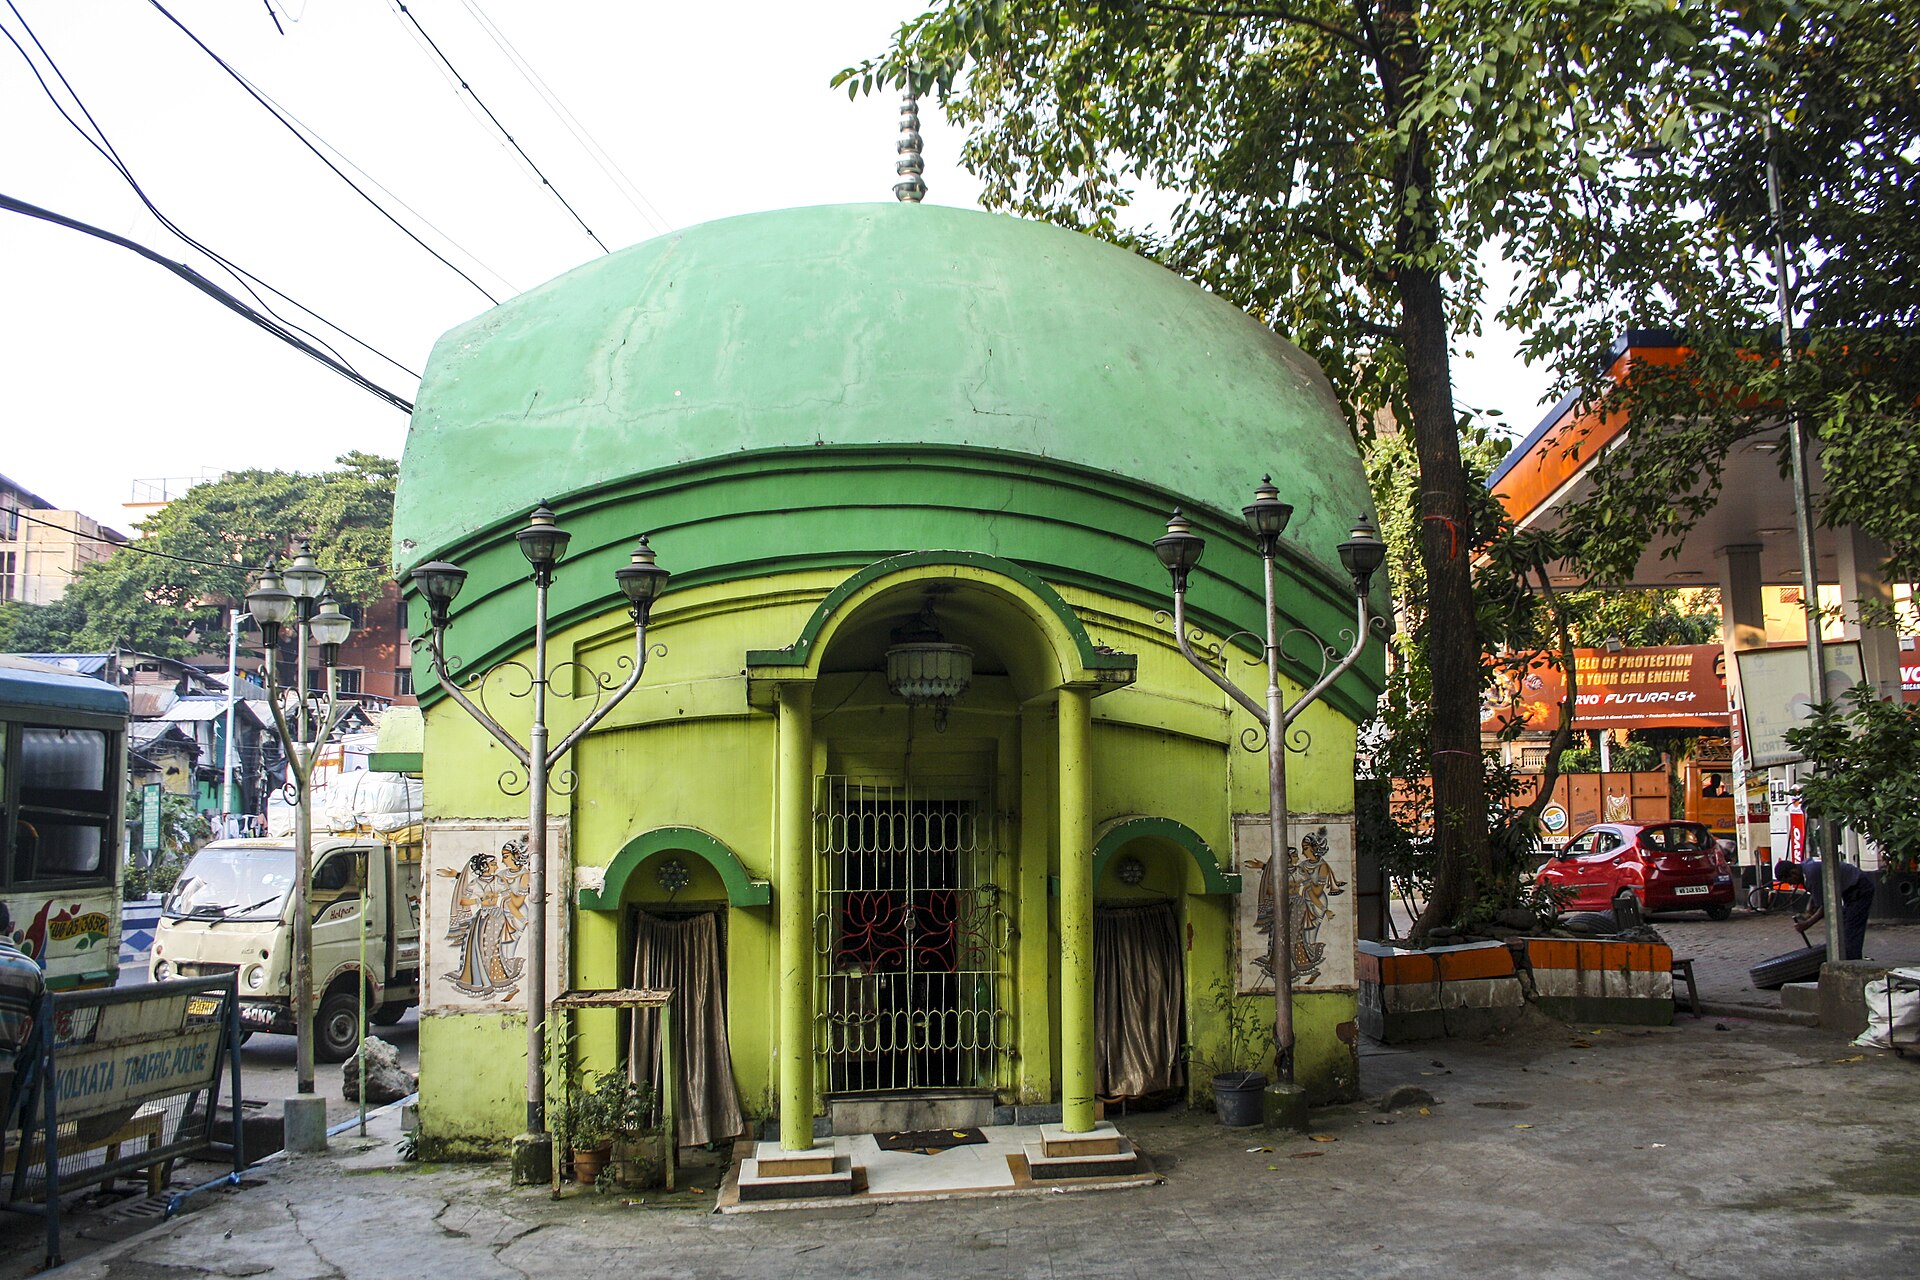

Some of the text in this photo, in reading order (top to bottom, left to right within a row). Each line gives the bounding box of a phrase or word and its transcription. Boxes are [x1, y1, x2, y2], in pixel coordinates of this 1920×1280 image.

[1574, 654, 1693, 670] IELD OF PROTECTION
[1561, 670, 1690, 687] FR YOUR CAR ENGINE
[1562, 694, 1600, 705] SRVO
[329, 905, 354, 920] Helper
[241, 1007, 277, 1025] 40KM
[55, 1043, 209, 1100] KOLKATA TRAFFIC POLICE
